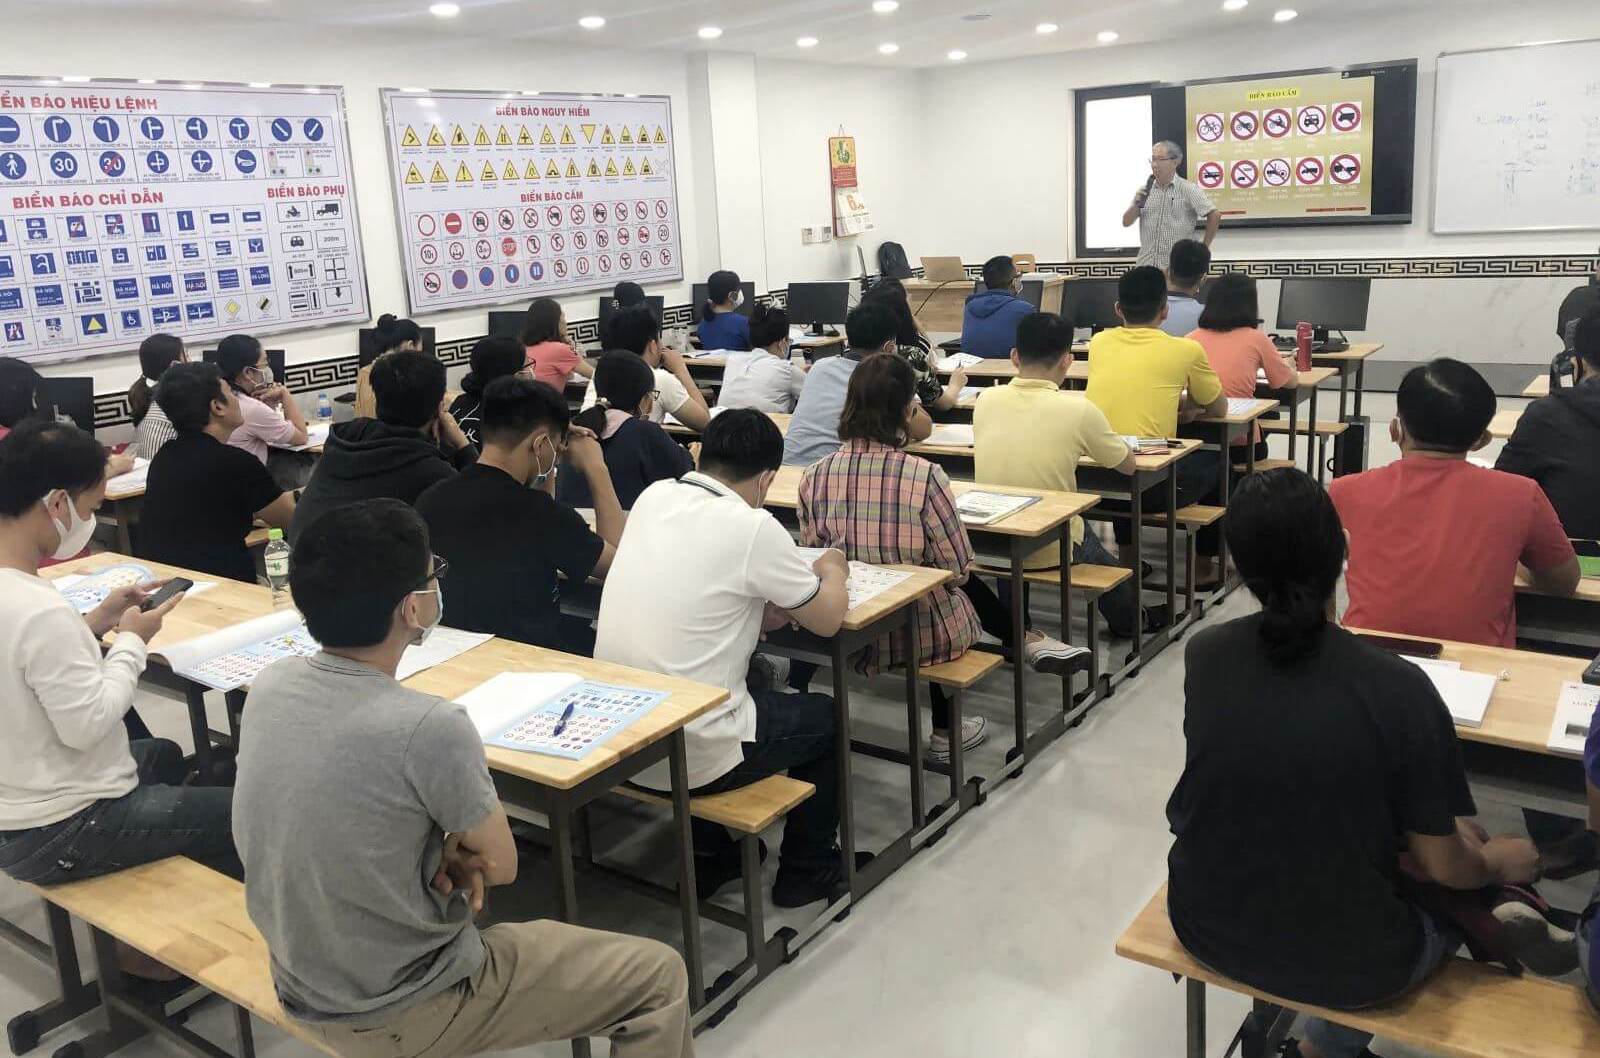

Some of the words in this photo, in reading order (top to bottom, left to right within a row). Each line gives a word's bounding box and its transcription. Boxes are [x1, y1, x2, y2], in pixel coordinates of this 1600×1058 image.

[30, 93, 66, 109] BÁO
[71, 95, 111, 112] HIỆU
[116, 95, 158, 113] LỆNH
[521, 104, 540, 116] BÁO
[541, 107, 566, 116] NGUY
[54, 158, 74, 171] 30
[267, 182, 295, 198] BIỂN
[297, 184, 321, 197] BÁO
[323, 185, 345, 197] PHỤ
[544, 190, 563, 201] BÁO
[12, 190, 55, 209] BIỂN
[59, 191, 94, 207] BÁO
[99, 189, 126, 205] CHỈ
[131, 187, 164, 203] DẪN
